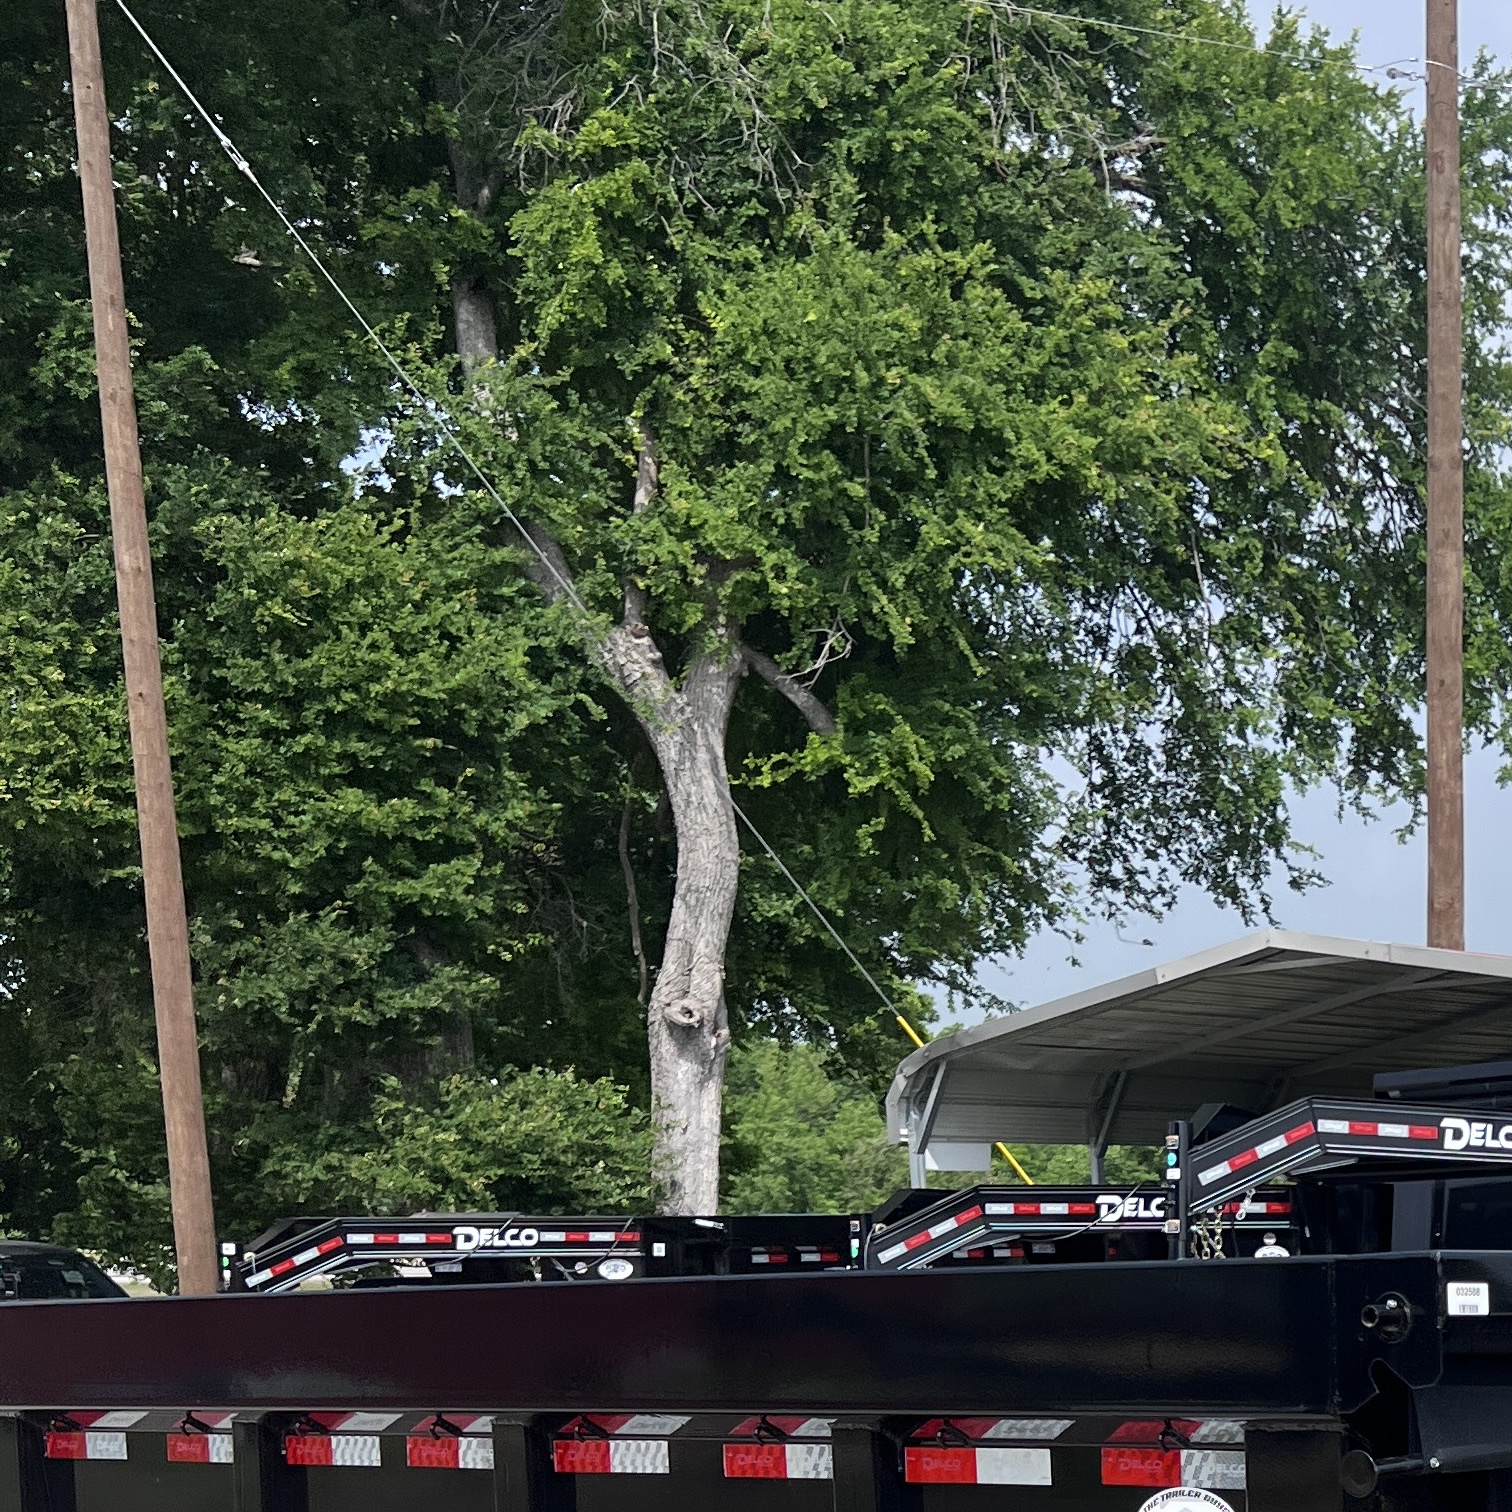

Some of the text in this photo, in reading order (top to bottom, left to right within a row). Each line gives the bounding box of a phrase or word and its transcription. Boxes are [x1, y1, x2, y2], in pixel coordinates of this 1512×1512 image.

[1096, 1194, 1166, 1222] DELC
[452, 1225, 540, 1251] DELCO
[1118, 1458, 1164, 1472] DELCO
[1160, 1489, 1202, 1502] TRAILER
